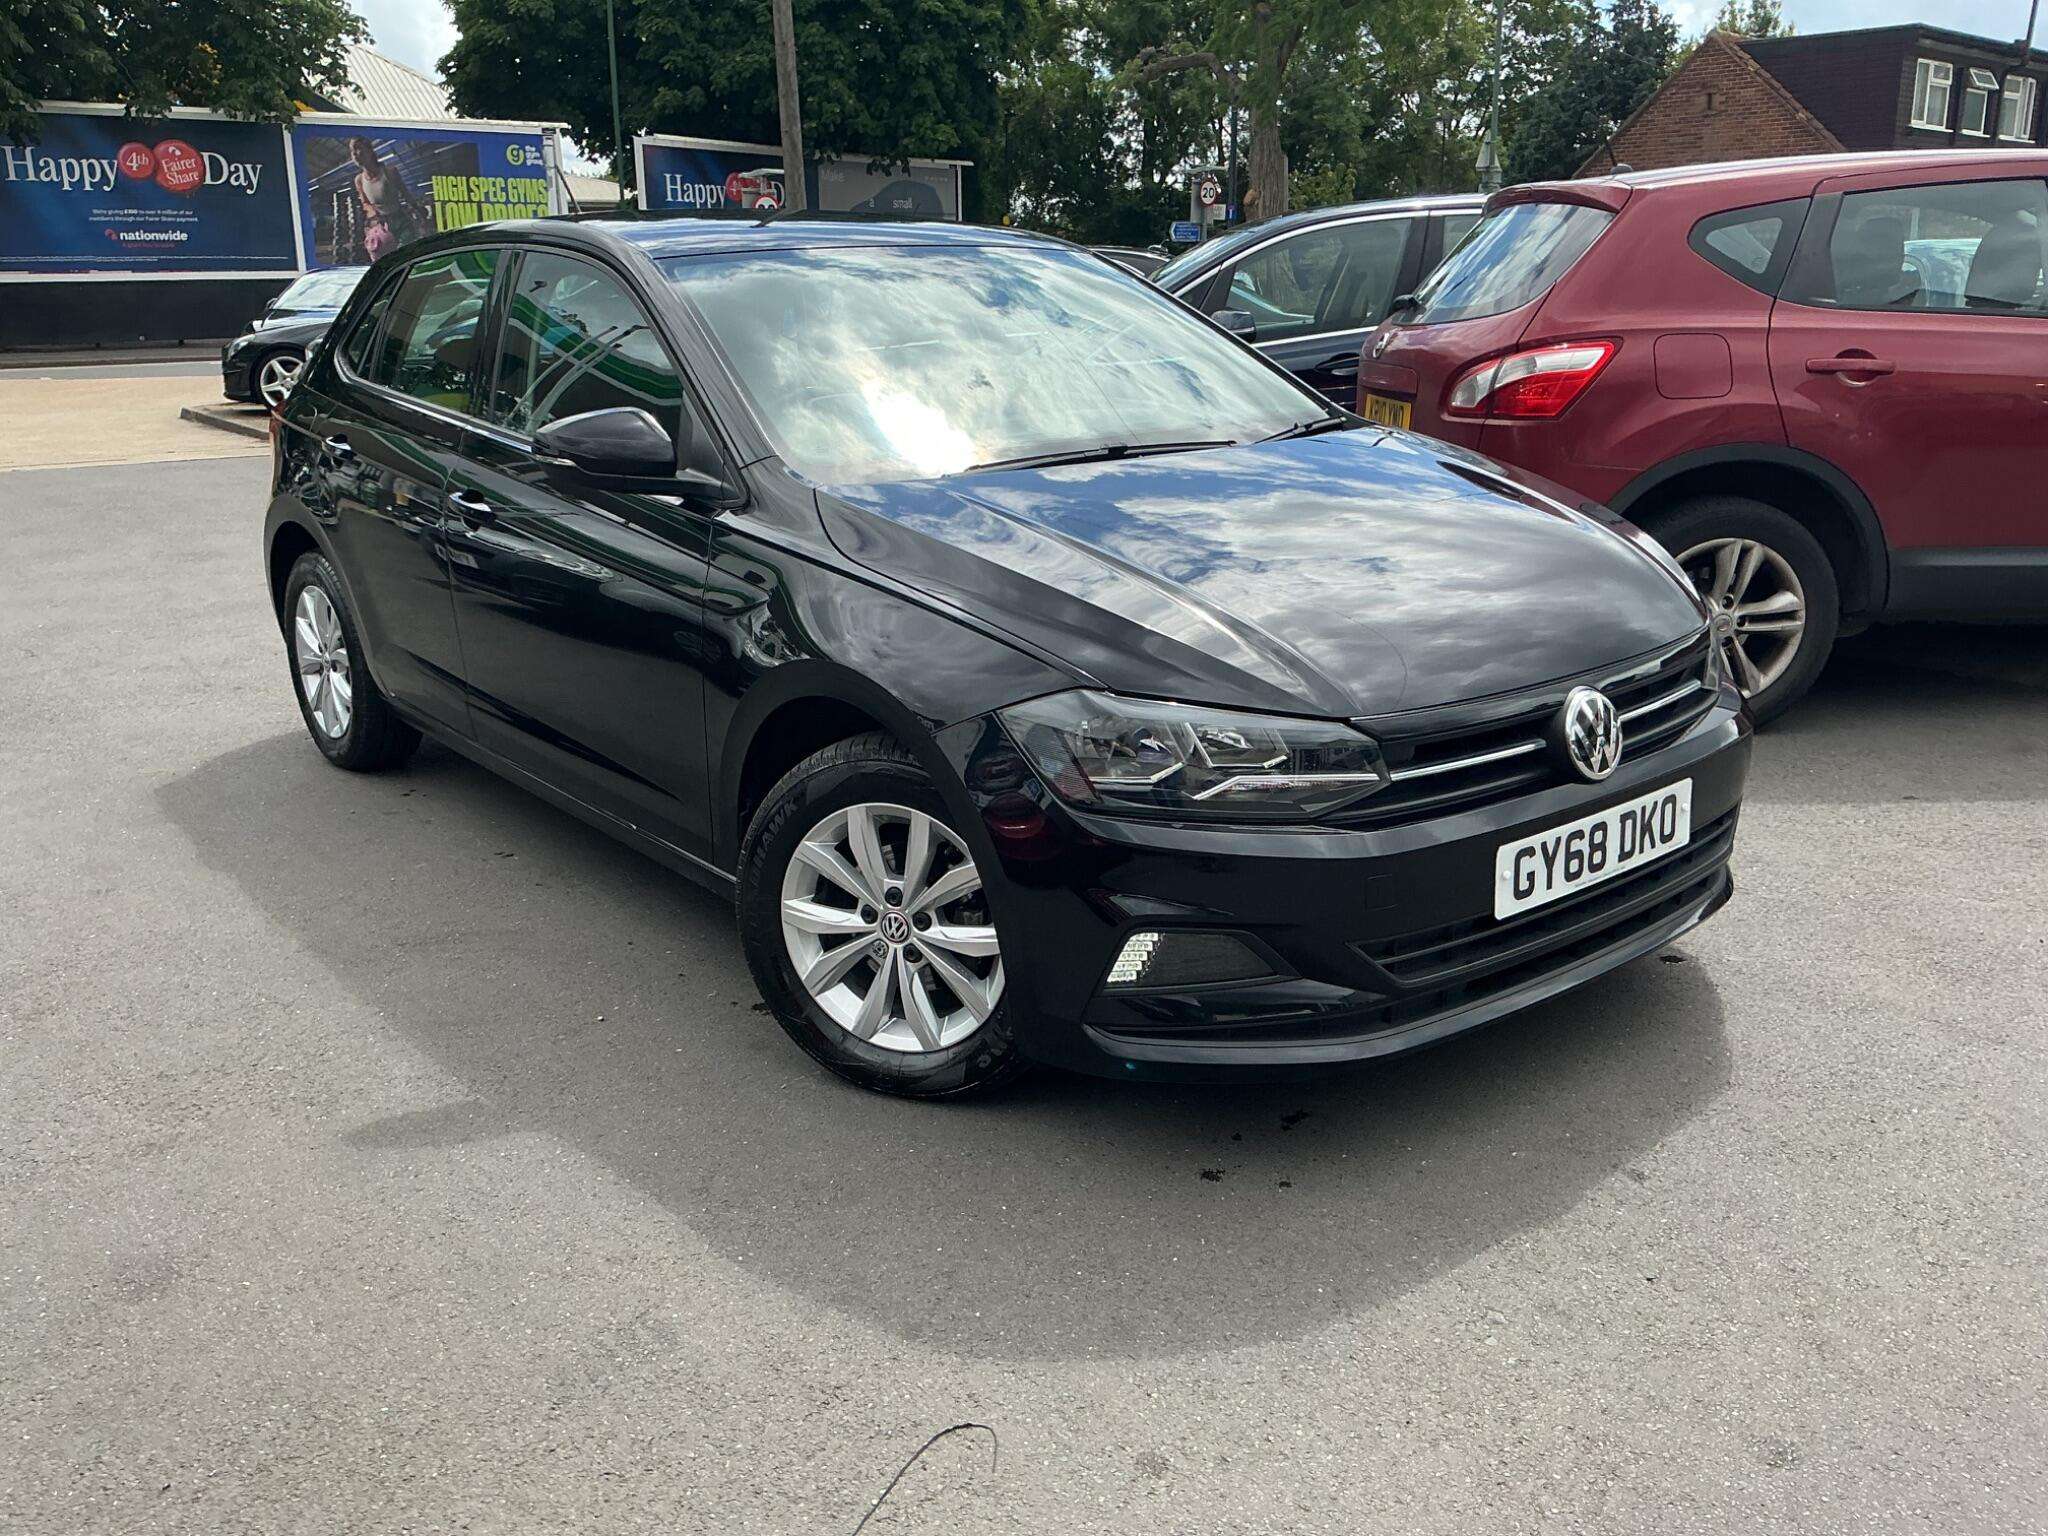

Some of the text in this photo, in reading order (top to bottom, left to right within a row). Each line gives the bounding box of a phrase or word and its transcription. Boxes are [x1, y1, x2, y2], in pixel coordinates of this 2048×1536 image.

[0, 145, 149, 192] Happy 4th
[162, 158, 197, 173] Fairer
[166, 171, 200, 185] Share
[200, 151, 263, 194] Day
[431, 175, 548, 203] HIGH SPEC GYMS
[663, 173, 727, 209] Happy
[1202, 187, 1215, 198] 20
[435, 202, 479, 233] LOW
[120, 229, 189, 241] nationwide
[1513, 794, 1677, 901] GY68 DKO
